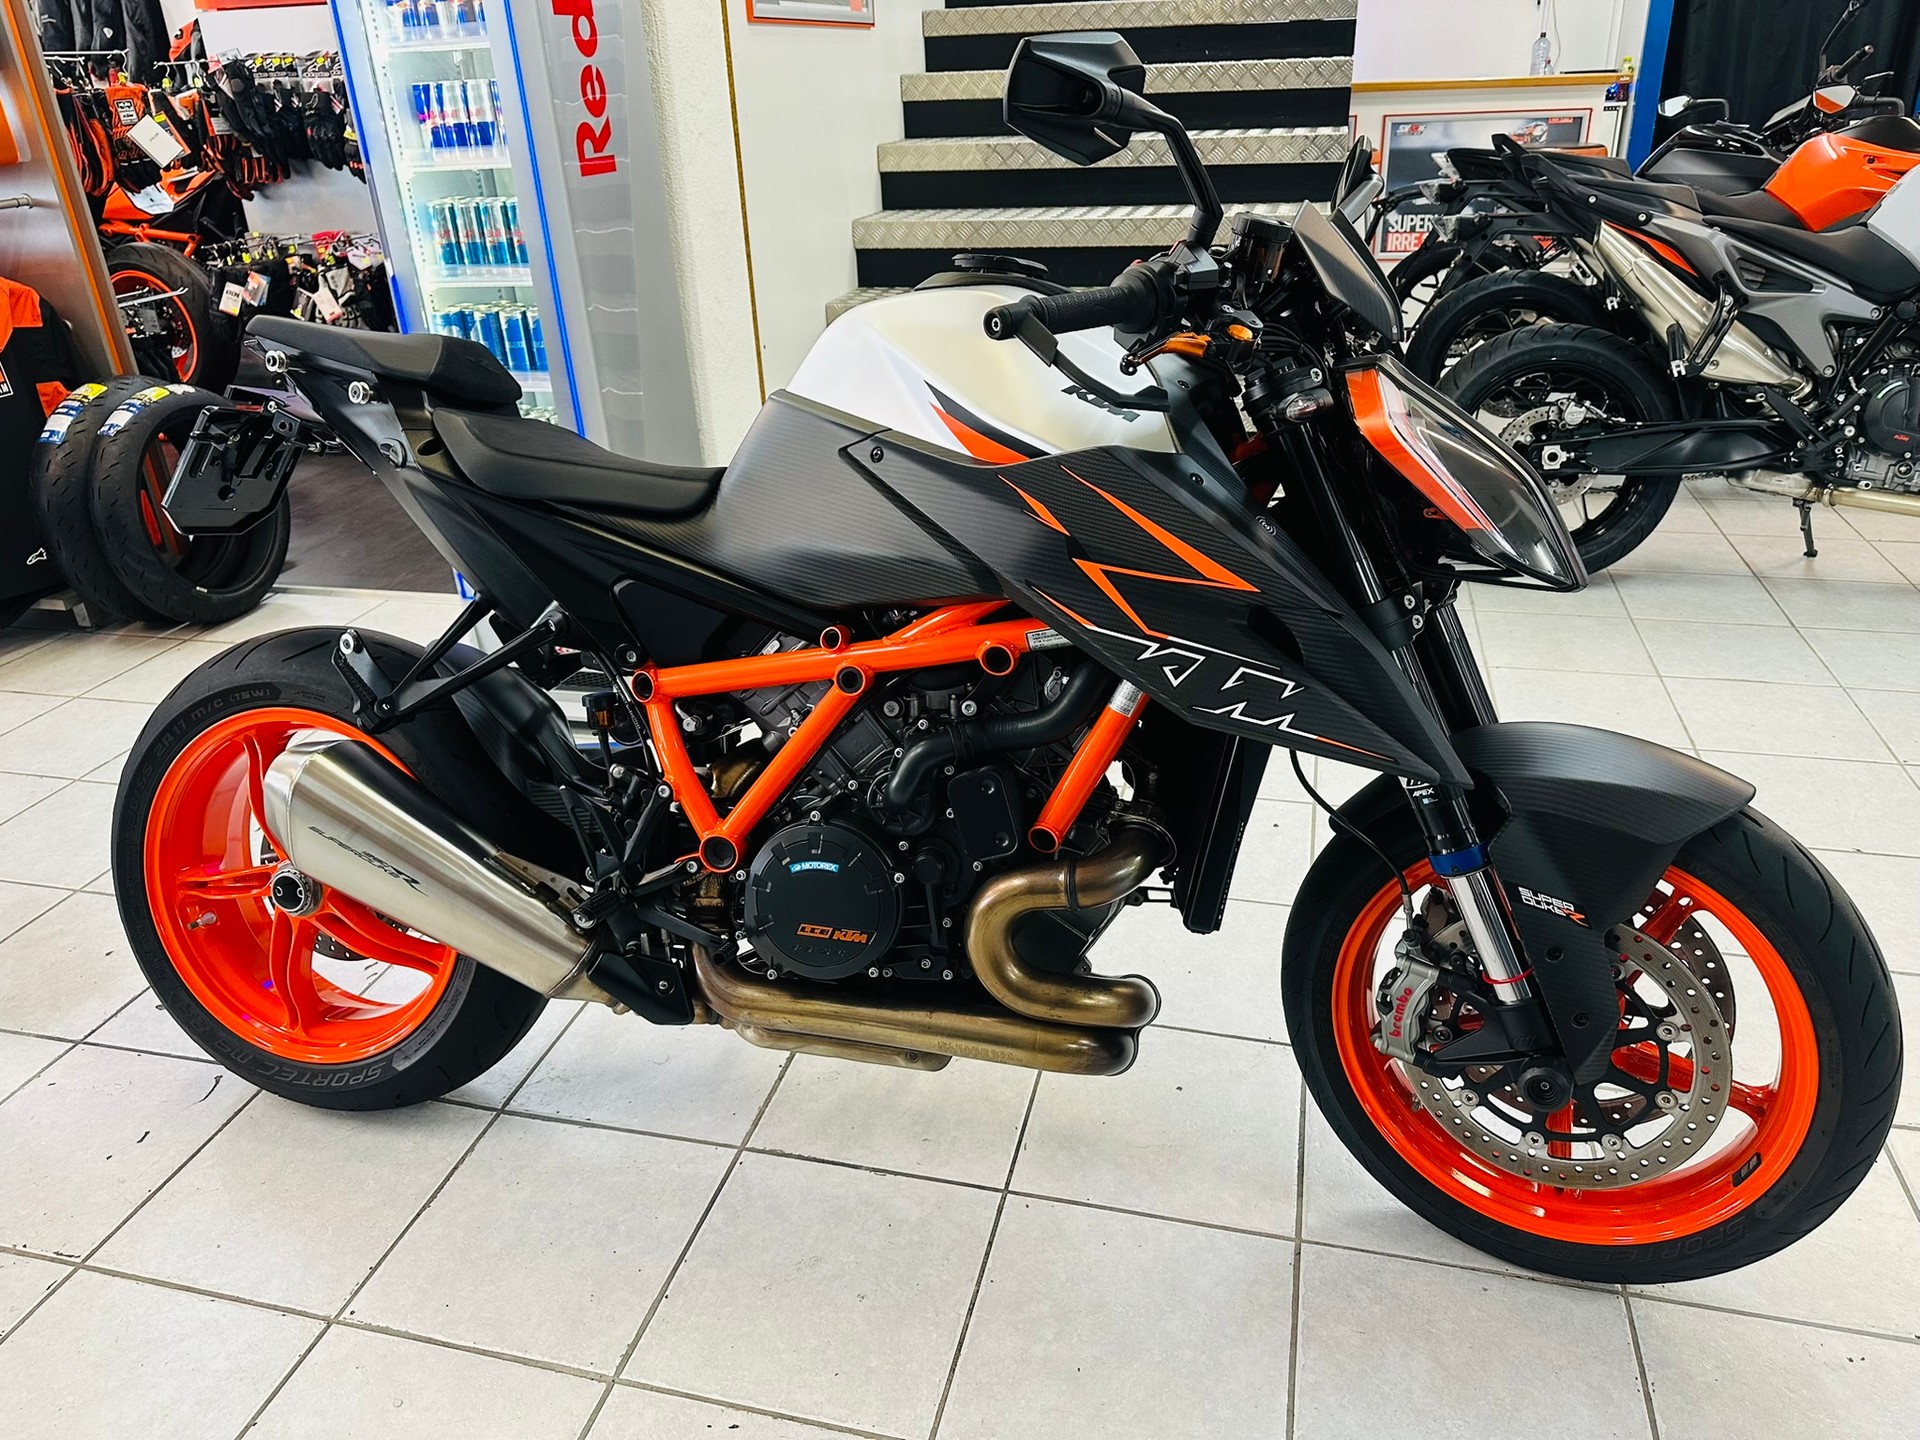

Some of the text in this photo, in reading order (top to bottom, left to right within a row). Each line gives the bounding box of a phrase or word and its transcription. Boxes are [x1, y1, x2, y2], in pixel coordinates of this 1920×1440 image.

[552, 0, 617, 177] Red
[1387, 213, 1439, 233] SUPER
[1412, 787, 1435, 798] APEX
[801, 861, 839, 872] MOTOREX
[1518, 886, 1575, 912] SUPER
[1521, 894, 1567, 917] DUKE
[832, 928, 868, 943] KTM
[1388, 987, 1414, 1038] brembo
[255, 1062, 387, 1088] SPORTEC
